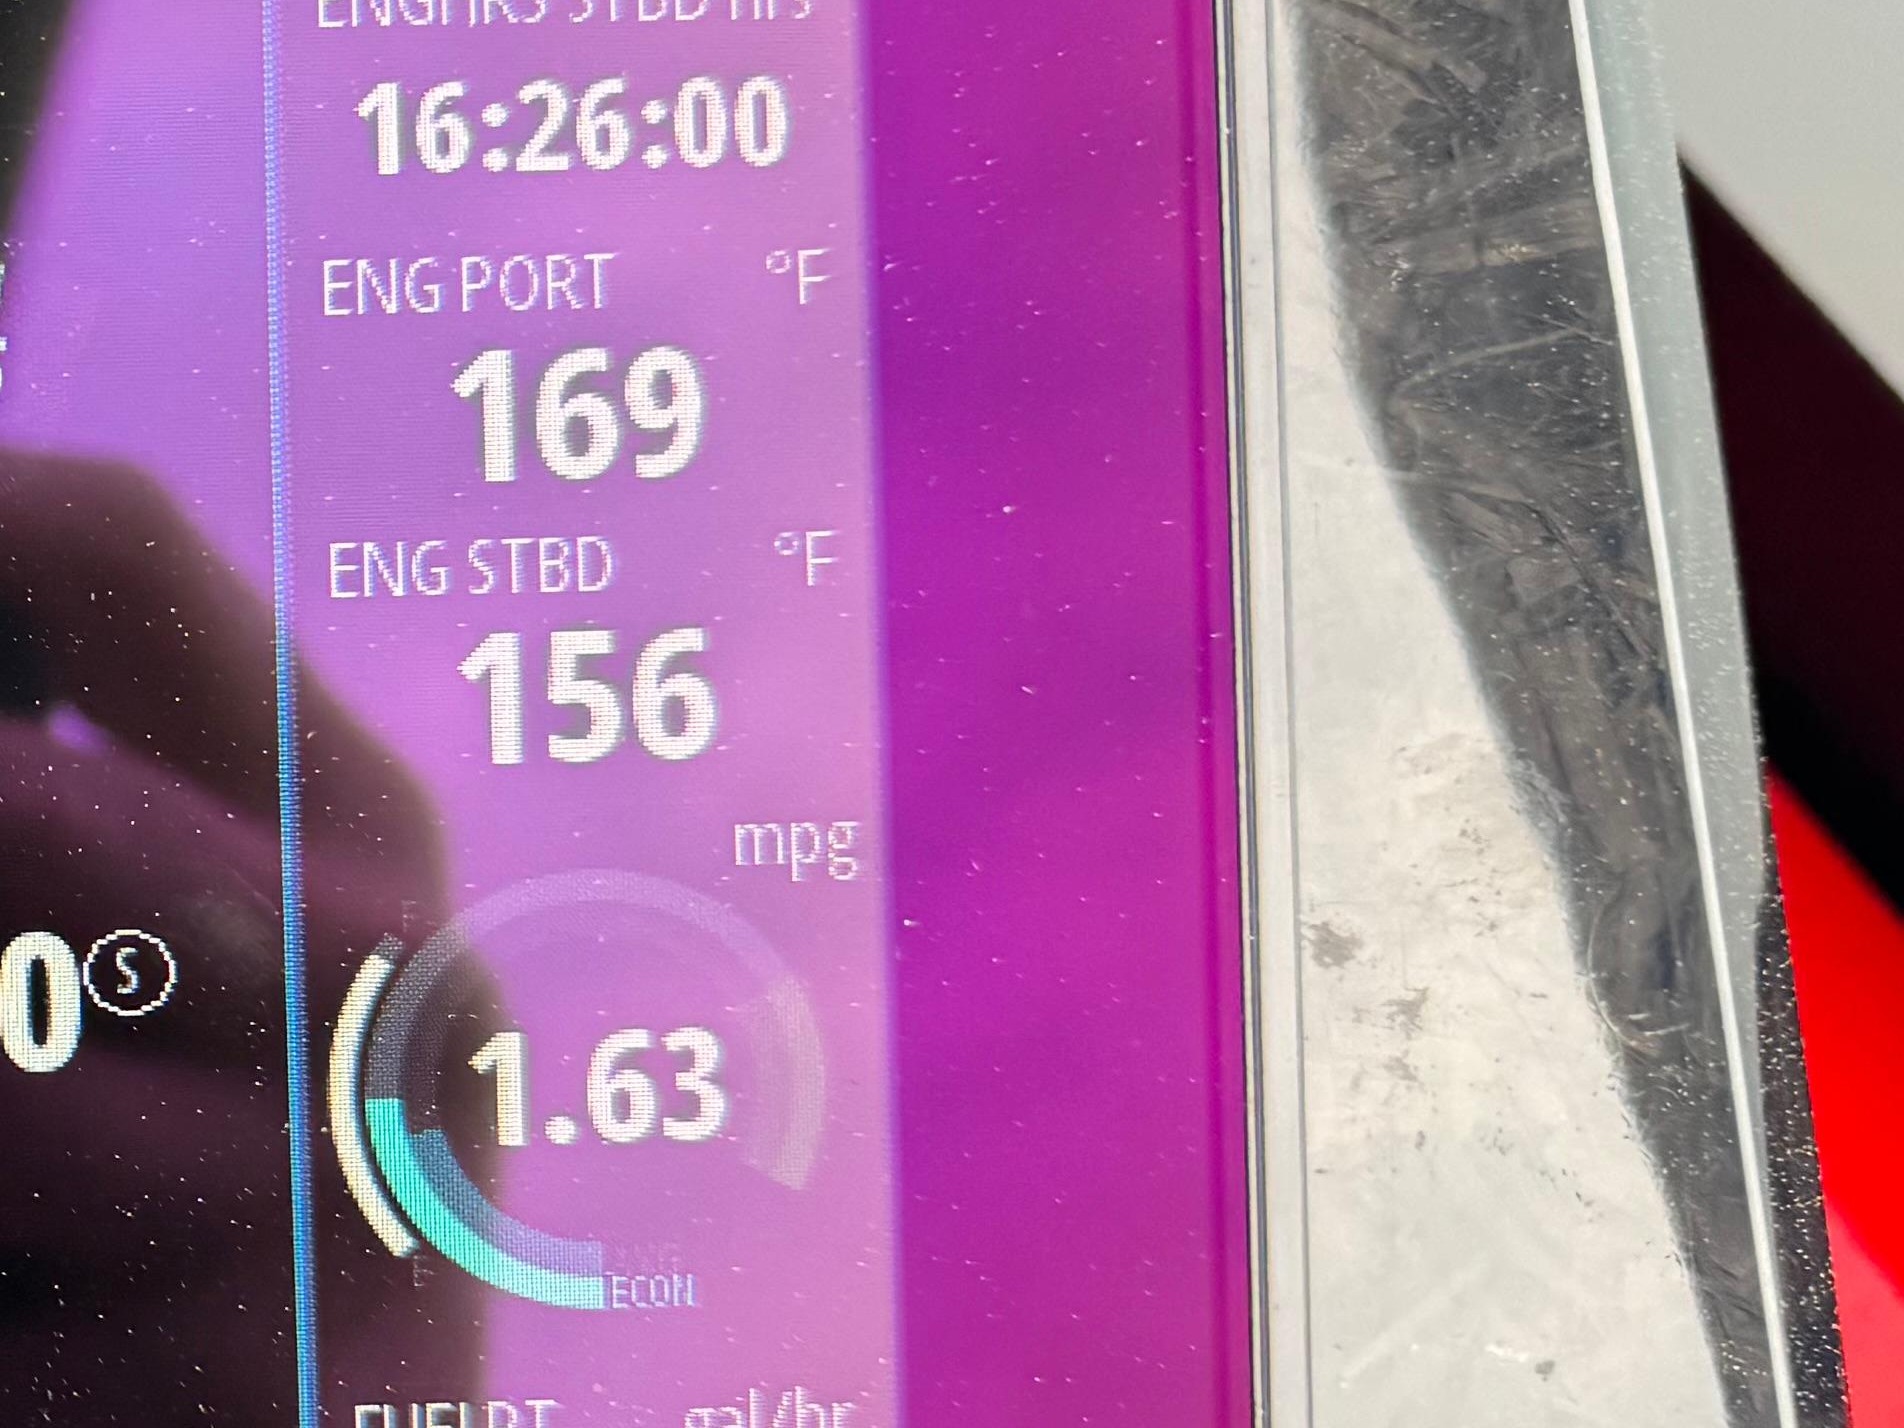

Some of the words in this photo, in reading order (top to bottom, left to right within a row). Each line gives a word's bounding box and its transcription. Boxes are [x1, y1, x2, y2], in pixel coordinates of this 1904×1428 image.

[354, 75, 792, 175] 16:26:00
[323, 255, 444, 316] ENG
[461, 252, 619, 313] PORT
[451, 345, 707, 485] 169
[329, 539, 449, 600] ENG
[468, 534, 614, 596] STBD
[456, 627, 719, 765] 156
[734, 817, 860, 883] mpg
[115, 949, 142, 995] S
[468, 1025, 728, 1149] 1.63
[611, 1274, 696, 1309] ECON
